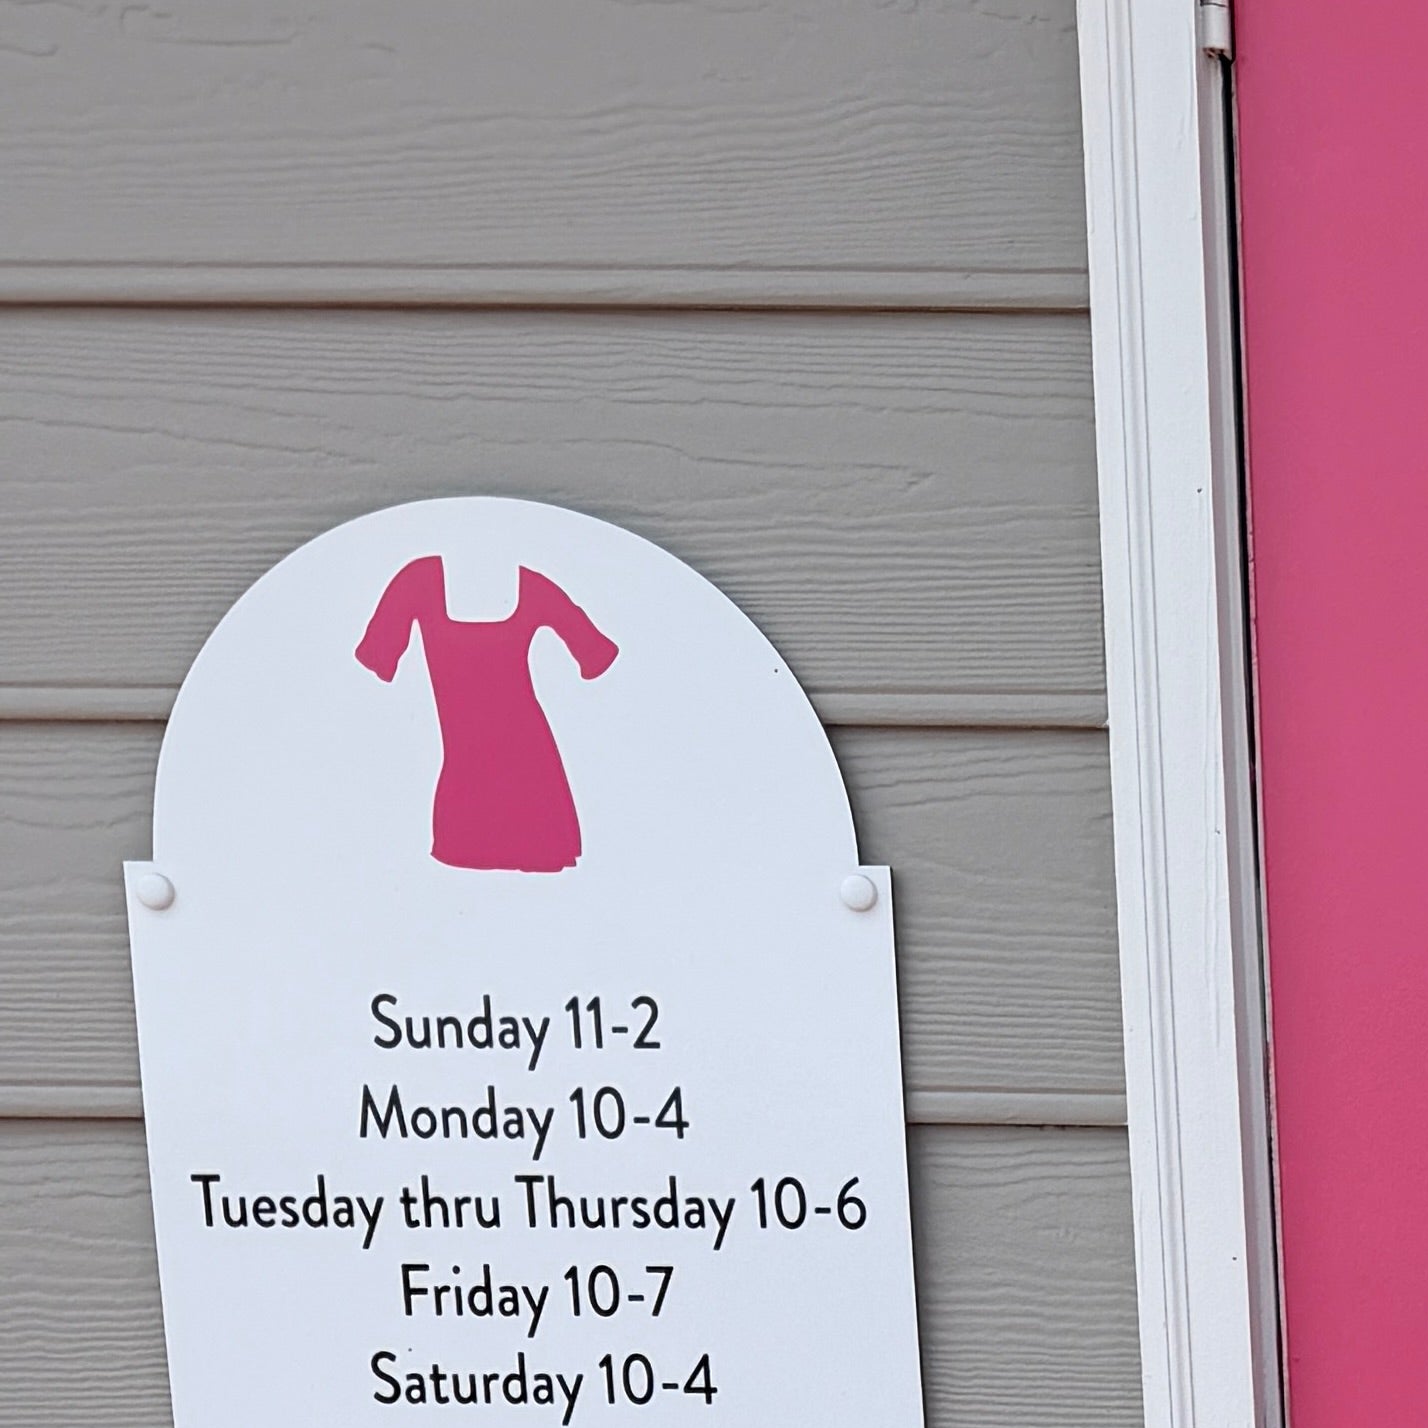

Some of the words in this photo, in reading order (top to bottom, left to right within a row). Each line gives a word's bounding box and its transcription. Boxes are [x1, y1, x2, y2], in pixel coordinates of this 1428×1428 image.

[371, 993, 551, 1072] Sunday
[565, 995, 661, 1049] 11-2
[359, 1084, 555, 1161] Monday
[569, 1086, 690, 1140] 10-4
[190, 1174, 384, 1250] Tuesday
[399, 1174, 501, 1229] thru
[514, 1174, 736, 1251] Thursday
[750, 1176, 867, 1231] 10-6
[401, 1263, 549, 1339] Friday
[564, 1264, 674, 1318] 10-7
[370, 1350, 584, 1427] Saturday
[598, 1353, 718, 1405] 10-4
